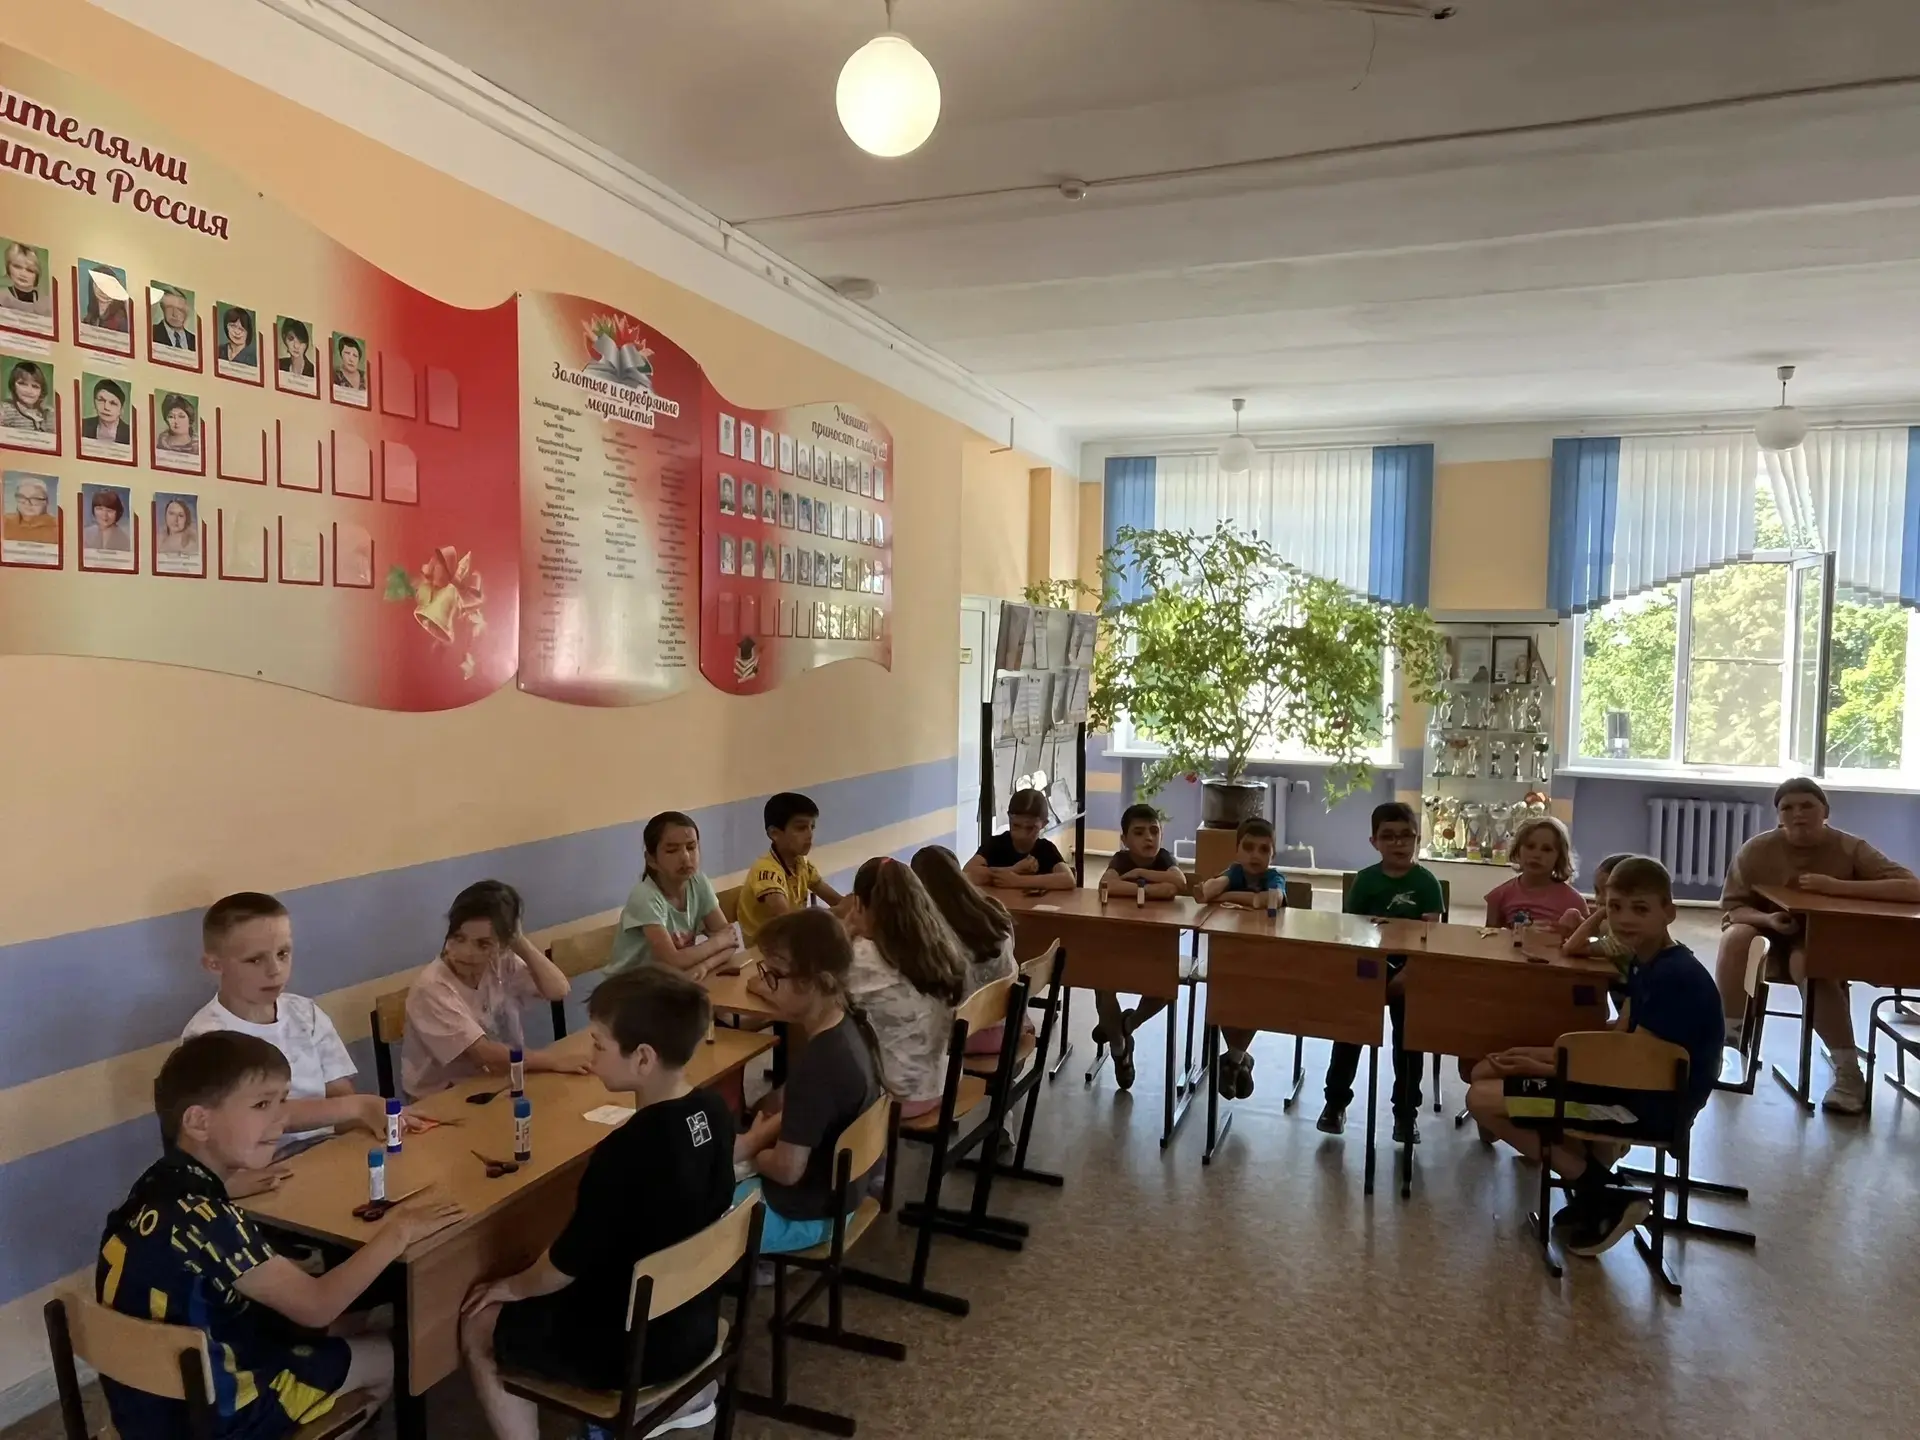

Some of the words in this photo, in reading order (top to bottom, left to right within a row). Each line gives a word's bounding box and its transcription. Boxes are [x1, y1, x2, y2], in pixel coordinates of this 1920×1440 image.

[106, 168, 229, 240] Россия
[552, 361, 608, 394] Золотые
[610, 385, 617, 398] и
[619, 387, 678, 416] серебряные
[585, 398, 653, 426] медалисты
[811, 421, 855, 448] приносят
